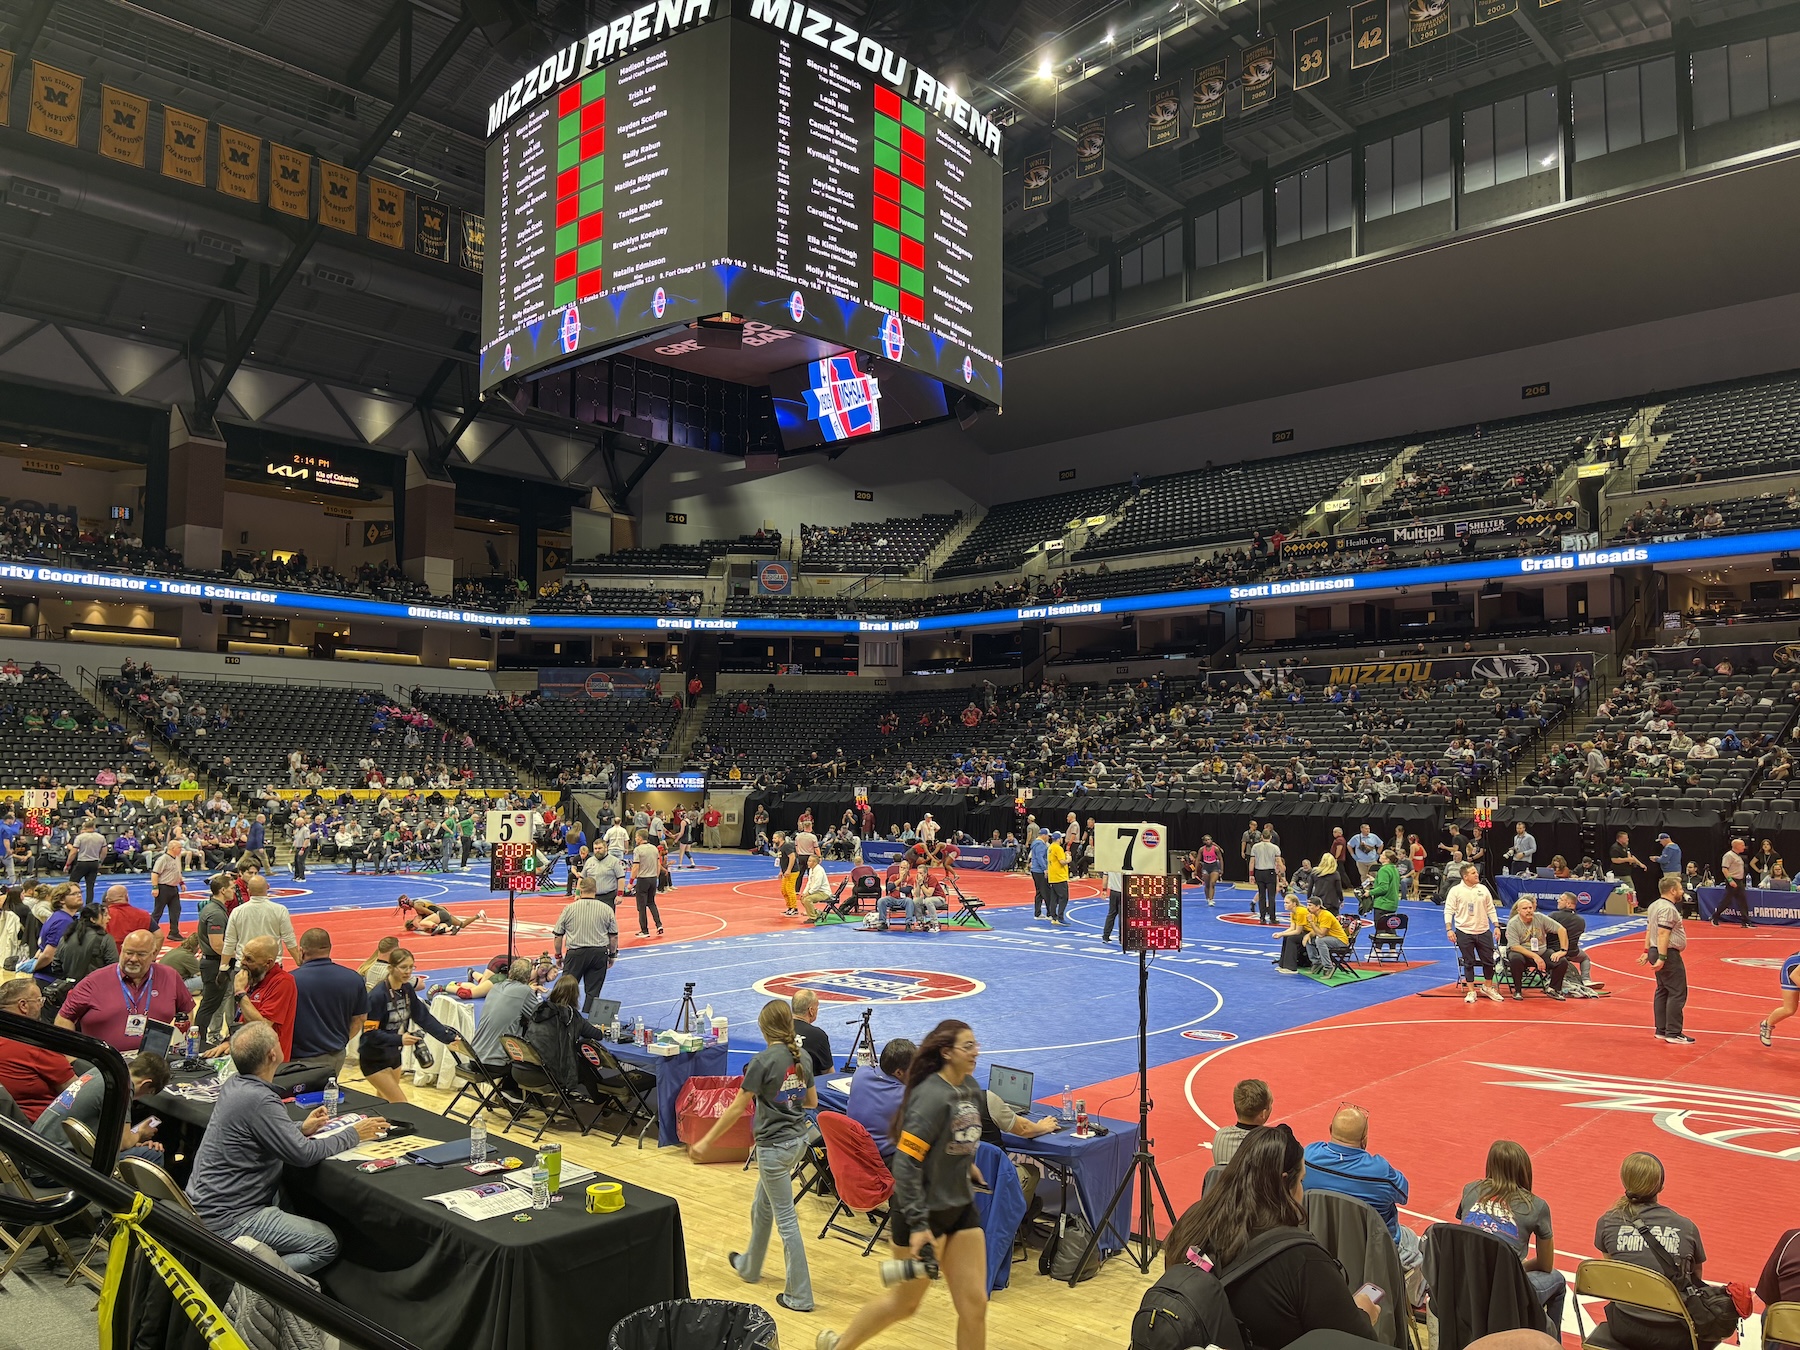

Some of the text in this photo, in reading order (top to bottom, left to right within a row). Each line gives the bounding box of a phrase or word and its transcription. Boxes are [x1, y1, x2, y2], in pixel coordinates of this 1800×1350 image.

[1487, 4, 1506, 15] 2003
[1357, 27, 1382, 49] 42
[487, 0, 712, 137] MIZZOU ARENA
[619, 50, 668, 76] Madison Smoot
[1300, 49, 1323, 73] 33
[750, 0, 907, 86] MIZZOU
[912, 67, 1000, 156] ARENA
[806, 59, 861, 90] Sierra Bromwich
[628, 84, 657, 101] Irish Lee
[819, 93, 849, 112] Leah Hill
[617, 109, 668, 134] Hayden Scorfina
[808, 118, 859, 145] Camille Palmer
[640, 141, 661, 154] Rabun
[835, 158, 860, 174] Brevett
[614, 167, 669, 193] Matilda Ridgeway
[812, 178, 855, 200] Kaylee Scott
[639, 199, 663, 212] Rhodes
[806, 205, 836, 222] Caroline
[835, 216, 859, 230] Owens
[612, 227, 669, 250] Brooklyn Koepkey
[807, 234, 858, 259] Ella Kimbrough
[613, 257, 666, 278] Natalie Edmisson
[665, 268, 676, 277] Fort
[677, 263, 694, 274] Osage
[805, 264, 825, 277] Molly
[759, 265, 776, 277] North
[776, 271, 798, 283] Kansas
[797, 277, 810, 287] City
[831, 288, 850, 300] Willard
[1525, 386, 1547, 397] 206
[1275, 431, 1292, 442] 207
[25, 460, 60, 471] 111-110
[294, 455, 330, 468] 2:14 PM
[315, 470, 326, 478] Kia
[333, 474, 359, 484] Columbia
[856, 491, 872, 500] 209
[668, 514, 685, 523] 210
[1468, 519, 1505, 530] SHELTER
[1346, 536, 1387, 547] Health Care
[1393, 524, 1445, 543] Multipli
[1520, 548, 1649, 573] Craig Meads
[38, 567, 148, 591] Coordinator
[159, 581, 202, 597] Todd
[204, 585, 278, 604] Schrader
[1229, 576, 1355, 599] Scott Robbinson
[407, 606, 531, 626] Officials Observers:
[1017, 601, 1102, 620] Larry Isenberg
[656, 618, 738, 630] Craig Frazier
[859, 619, 920, 631] Brad Neely
[1329, 661, 1433, 684] MIZZOU
[645, 777, 705, 785] MARINES
[43, 791, 49, 807] 3
[1483, 797, 1490, 808] 6
[499, 813, 513, 841] 5
[495, 843, 533, 857] 2083
[1117, 828, 1139, 870] 7
[504, 857, 534, 872] 3 0
[508, 876, 534, 889] 1:08
[1128, 876, 1177, 897] 2081
[1139, 898, 1178, 919] 4 2
[1147, 927, 1179, 948] 1:09
